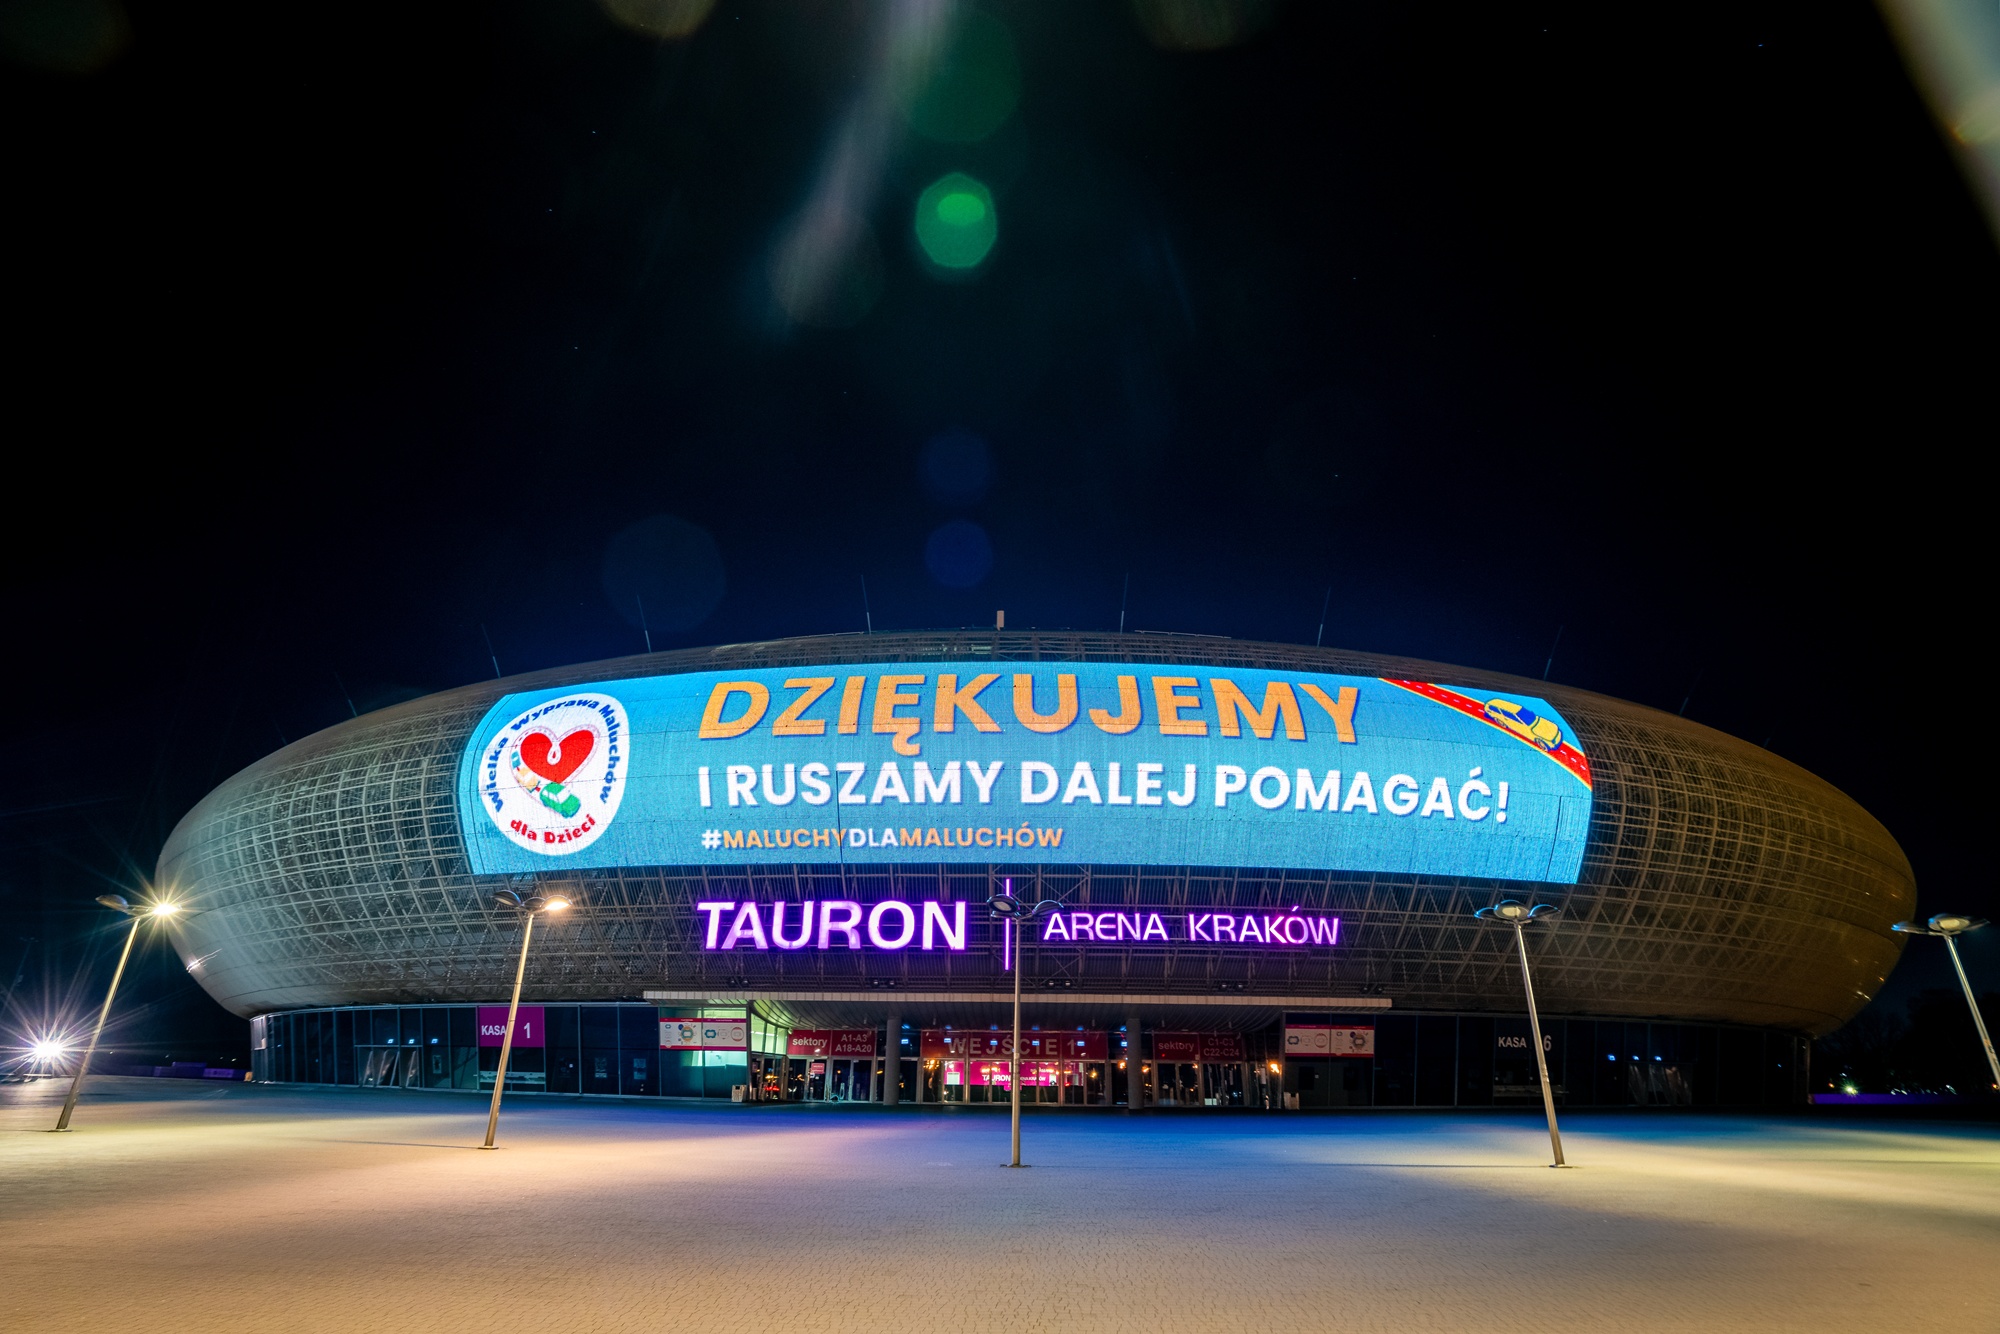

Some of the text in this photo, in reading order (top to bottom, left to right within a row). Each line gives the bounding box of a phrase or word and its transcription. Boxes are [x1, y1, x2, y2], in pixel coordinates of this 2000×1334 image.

[699, 673, 1359, 756] DZIĘKUJEMY
[486, 699, 621, 812] Wielka Wyprawa Maluchów
[698, 761, 1509, 823] I RUSZAMY DALEJ POMAGAĆ!
[510, 814, 596, 844] dla Dzieci
[701, 823, 1063, 850] #MALUCHYDLAMALUCHÓW
[696, 900, 967, 952] TAURON
[1043, 905, 1342, 946] ARENA KRAKÓW
[481, 1022, 531, 1039] KASA 1
[841, 1034, 867, 1042] A1-A3
[792, 1038, 828, 1048] sektory
[835, 1044, 872, 1052] A18-A20
[949, 1035, 1058, 1055] WEJŚCIE
[1158, 1041, 1194, 1051] sektory
[1498, 1035, 1552, 1051] KASA 6
